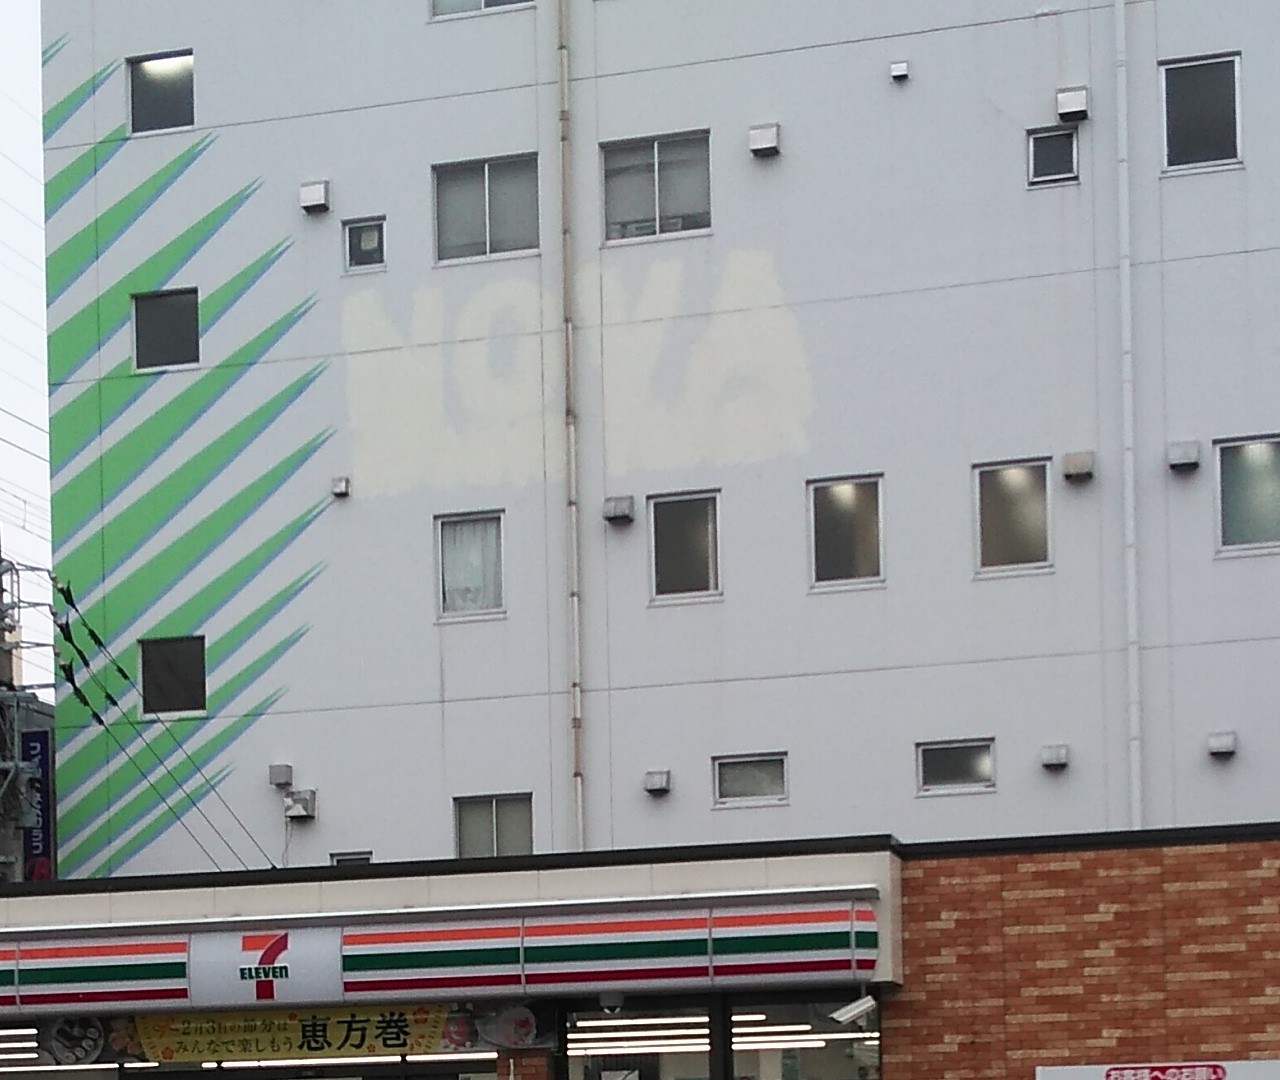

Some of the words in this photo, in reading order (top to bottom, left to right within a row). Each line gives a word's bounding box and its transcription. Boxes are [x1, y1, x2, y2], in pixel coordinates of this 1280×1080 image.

[175, 1036, 293, 1054] みんなで楽しもう
[297, 1011, 411, 1052] 恵方巻
